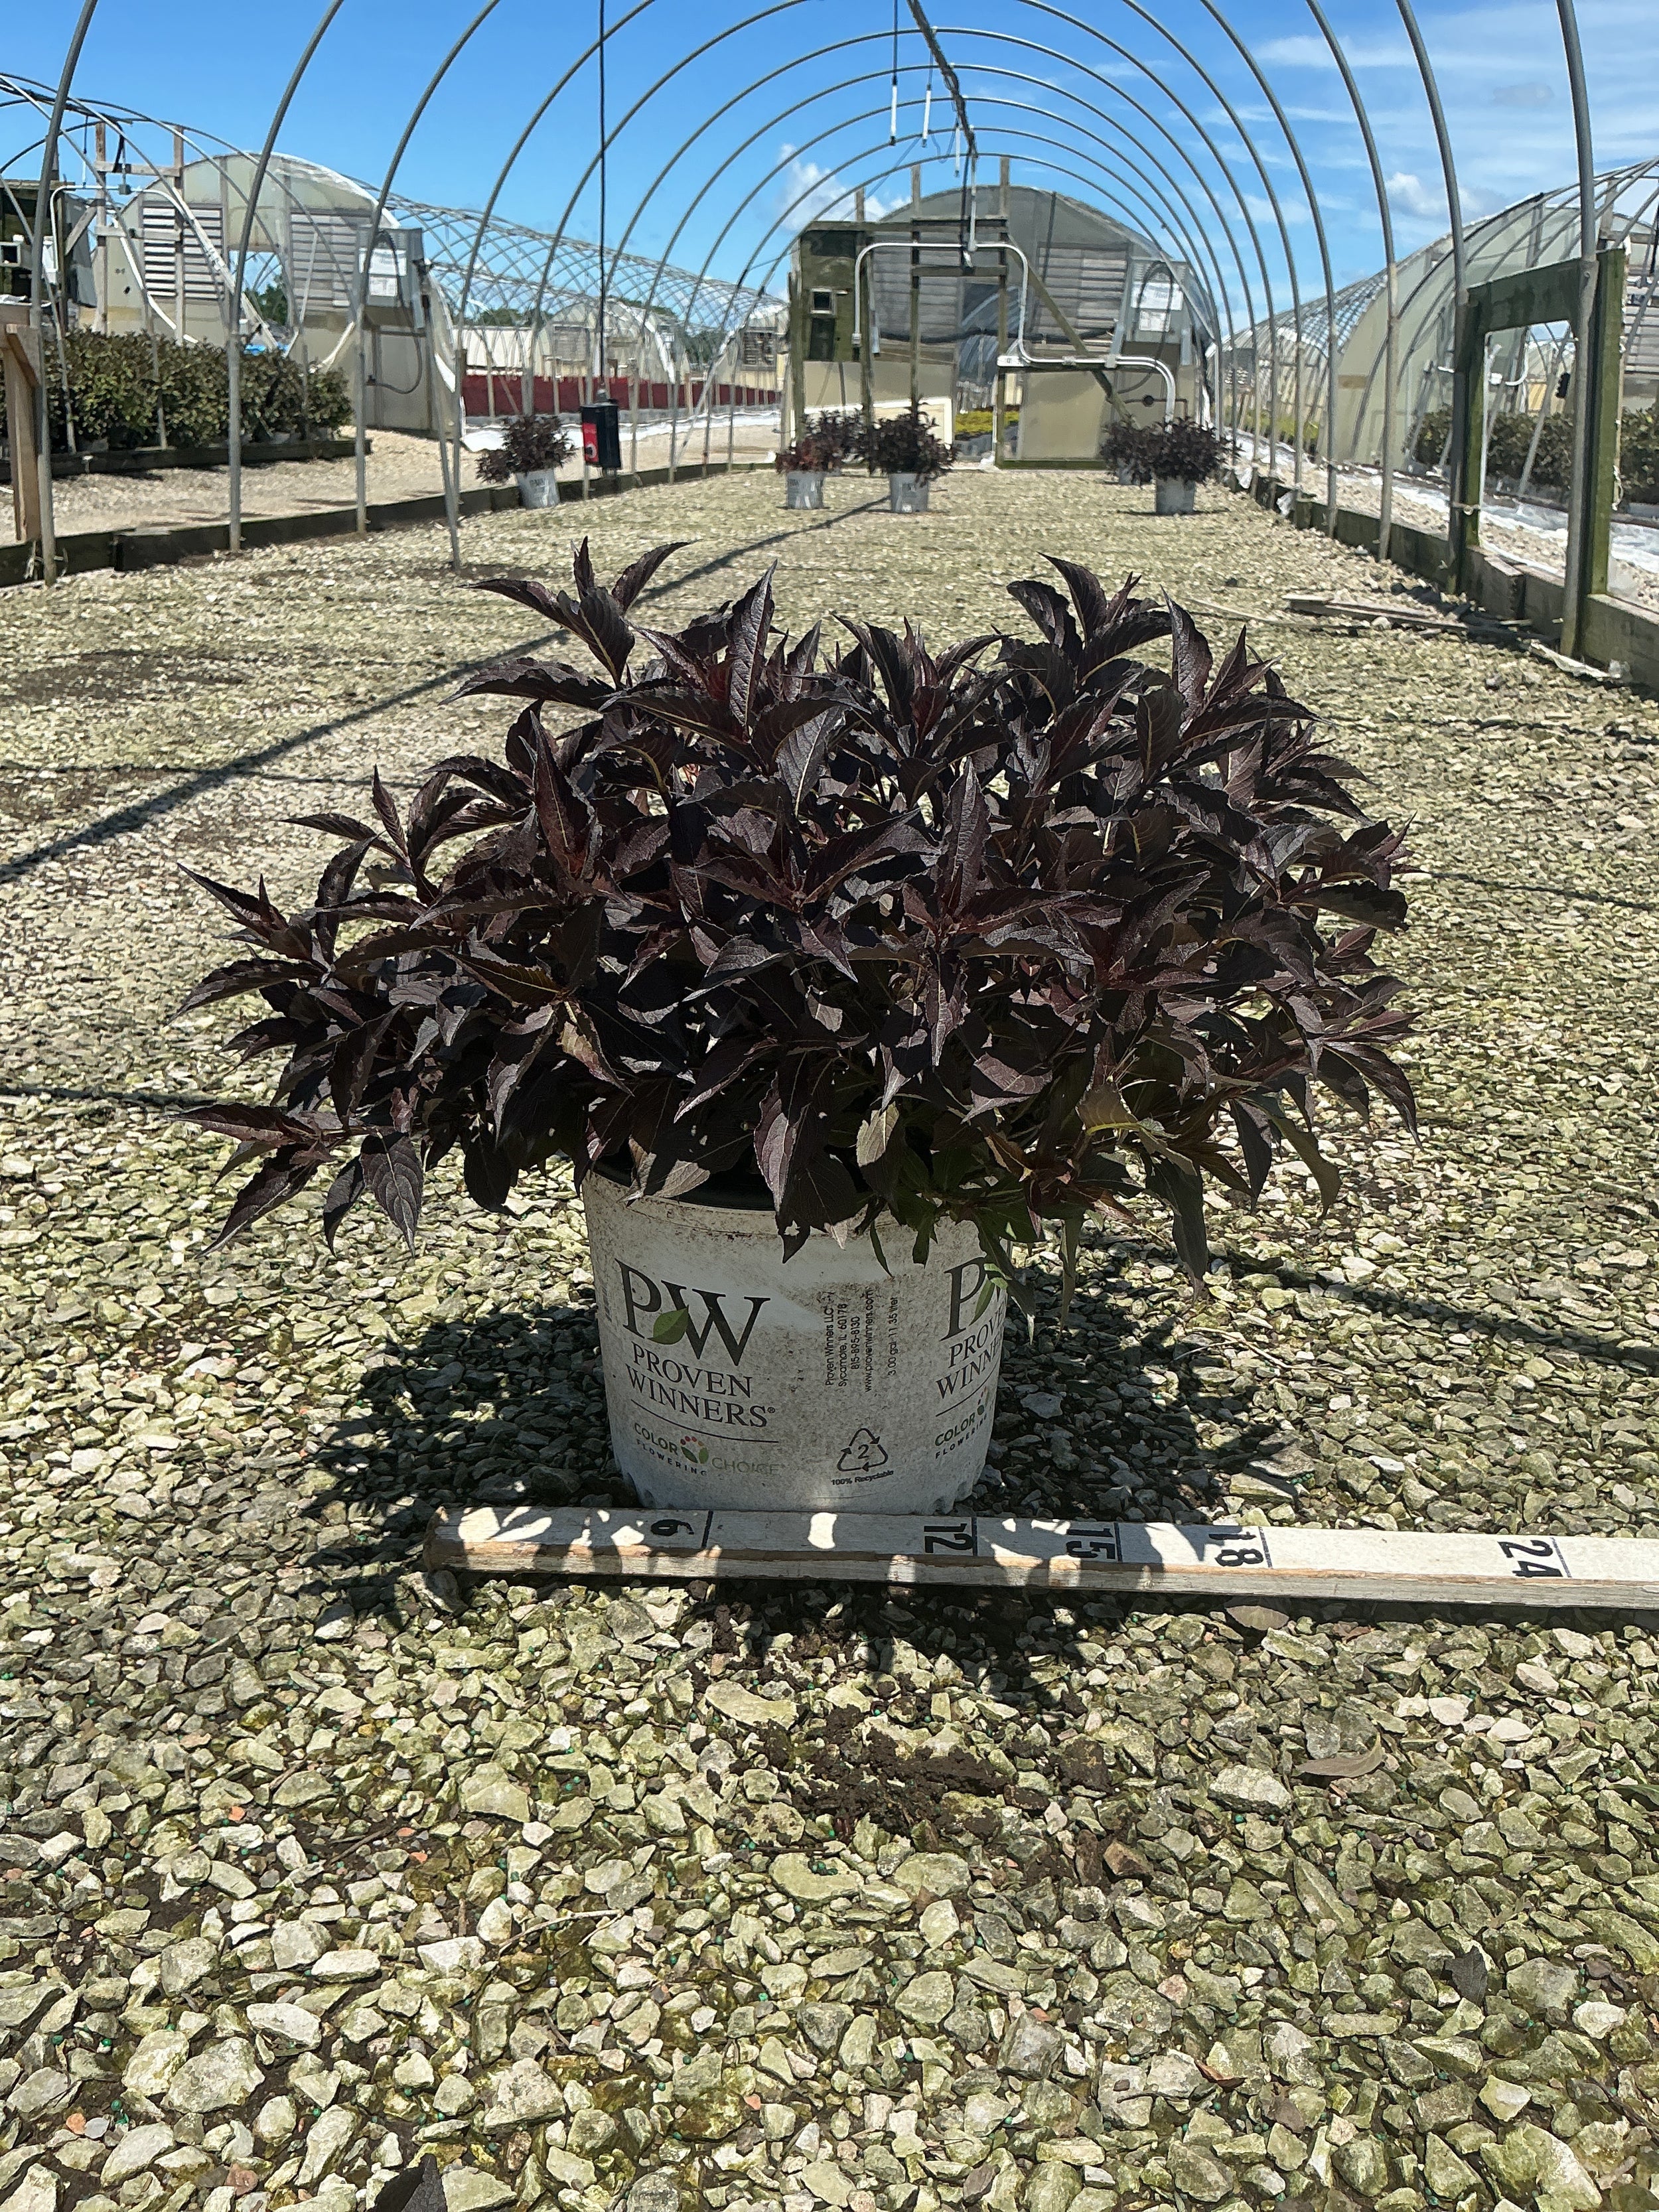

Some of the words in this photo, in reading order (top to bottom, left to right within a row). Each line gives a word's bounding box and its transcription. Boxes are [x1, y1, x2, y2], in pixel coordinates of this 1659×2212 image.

[614, 1258, 771, 1366] PW
[824, 1308, 834, 1323] LLC
[889, 1297, 898, 1312] liter
[939, 1256, 1001, 1341] P
[837, 1303, 848, 1329] 60178
[825, 1325, 834, 1357] Winners
[851, 1317, 860, 1370] 815-895-8130
[865, 1290, 874, 1392] www.provenwinners.com
[889, 1341, 899, 1355] gal
[631, 1341, 753, 1398] PROVEN
[825, 1358, 834, 1386] Proven
[838, 1343, 848, 1387] Sycamore,
[634, 1422, 678, 1456] COLOR
[935, 1412, 975, 1446] COLOR
[936, 1412, 987, 1459] FLOWERING
[636, 1439, 707, 1477] FLOWERING
[858, 1444, 870, 1459] 2
[855, 1470, 894, 1483] Recyclable
[651, 1519, 695, 1536] 6
[924, 1523, 974, 1554] 12
[1066, 1528, 1116, 1560] 15
[1208, 1531, 1263, 1567] 18
[1497, 1540, 1563, 1578] 24
